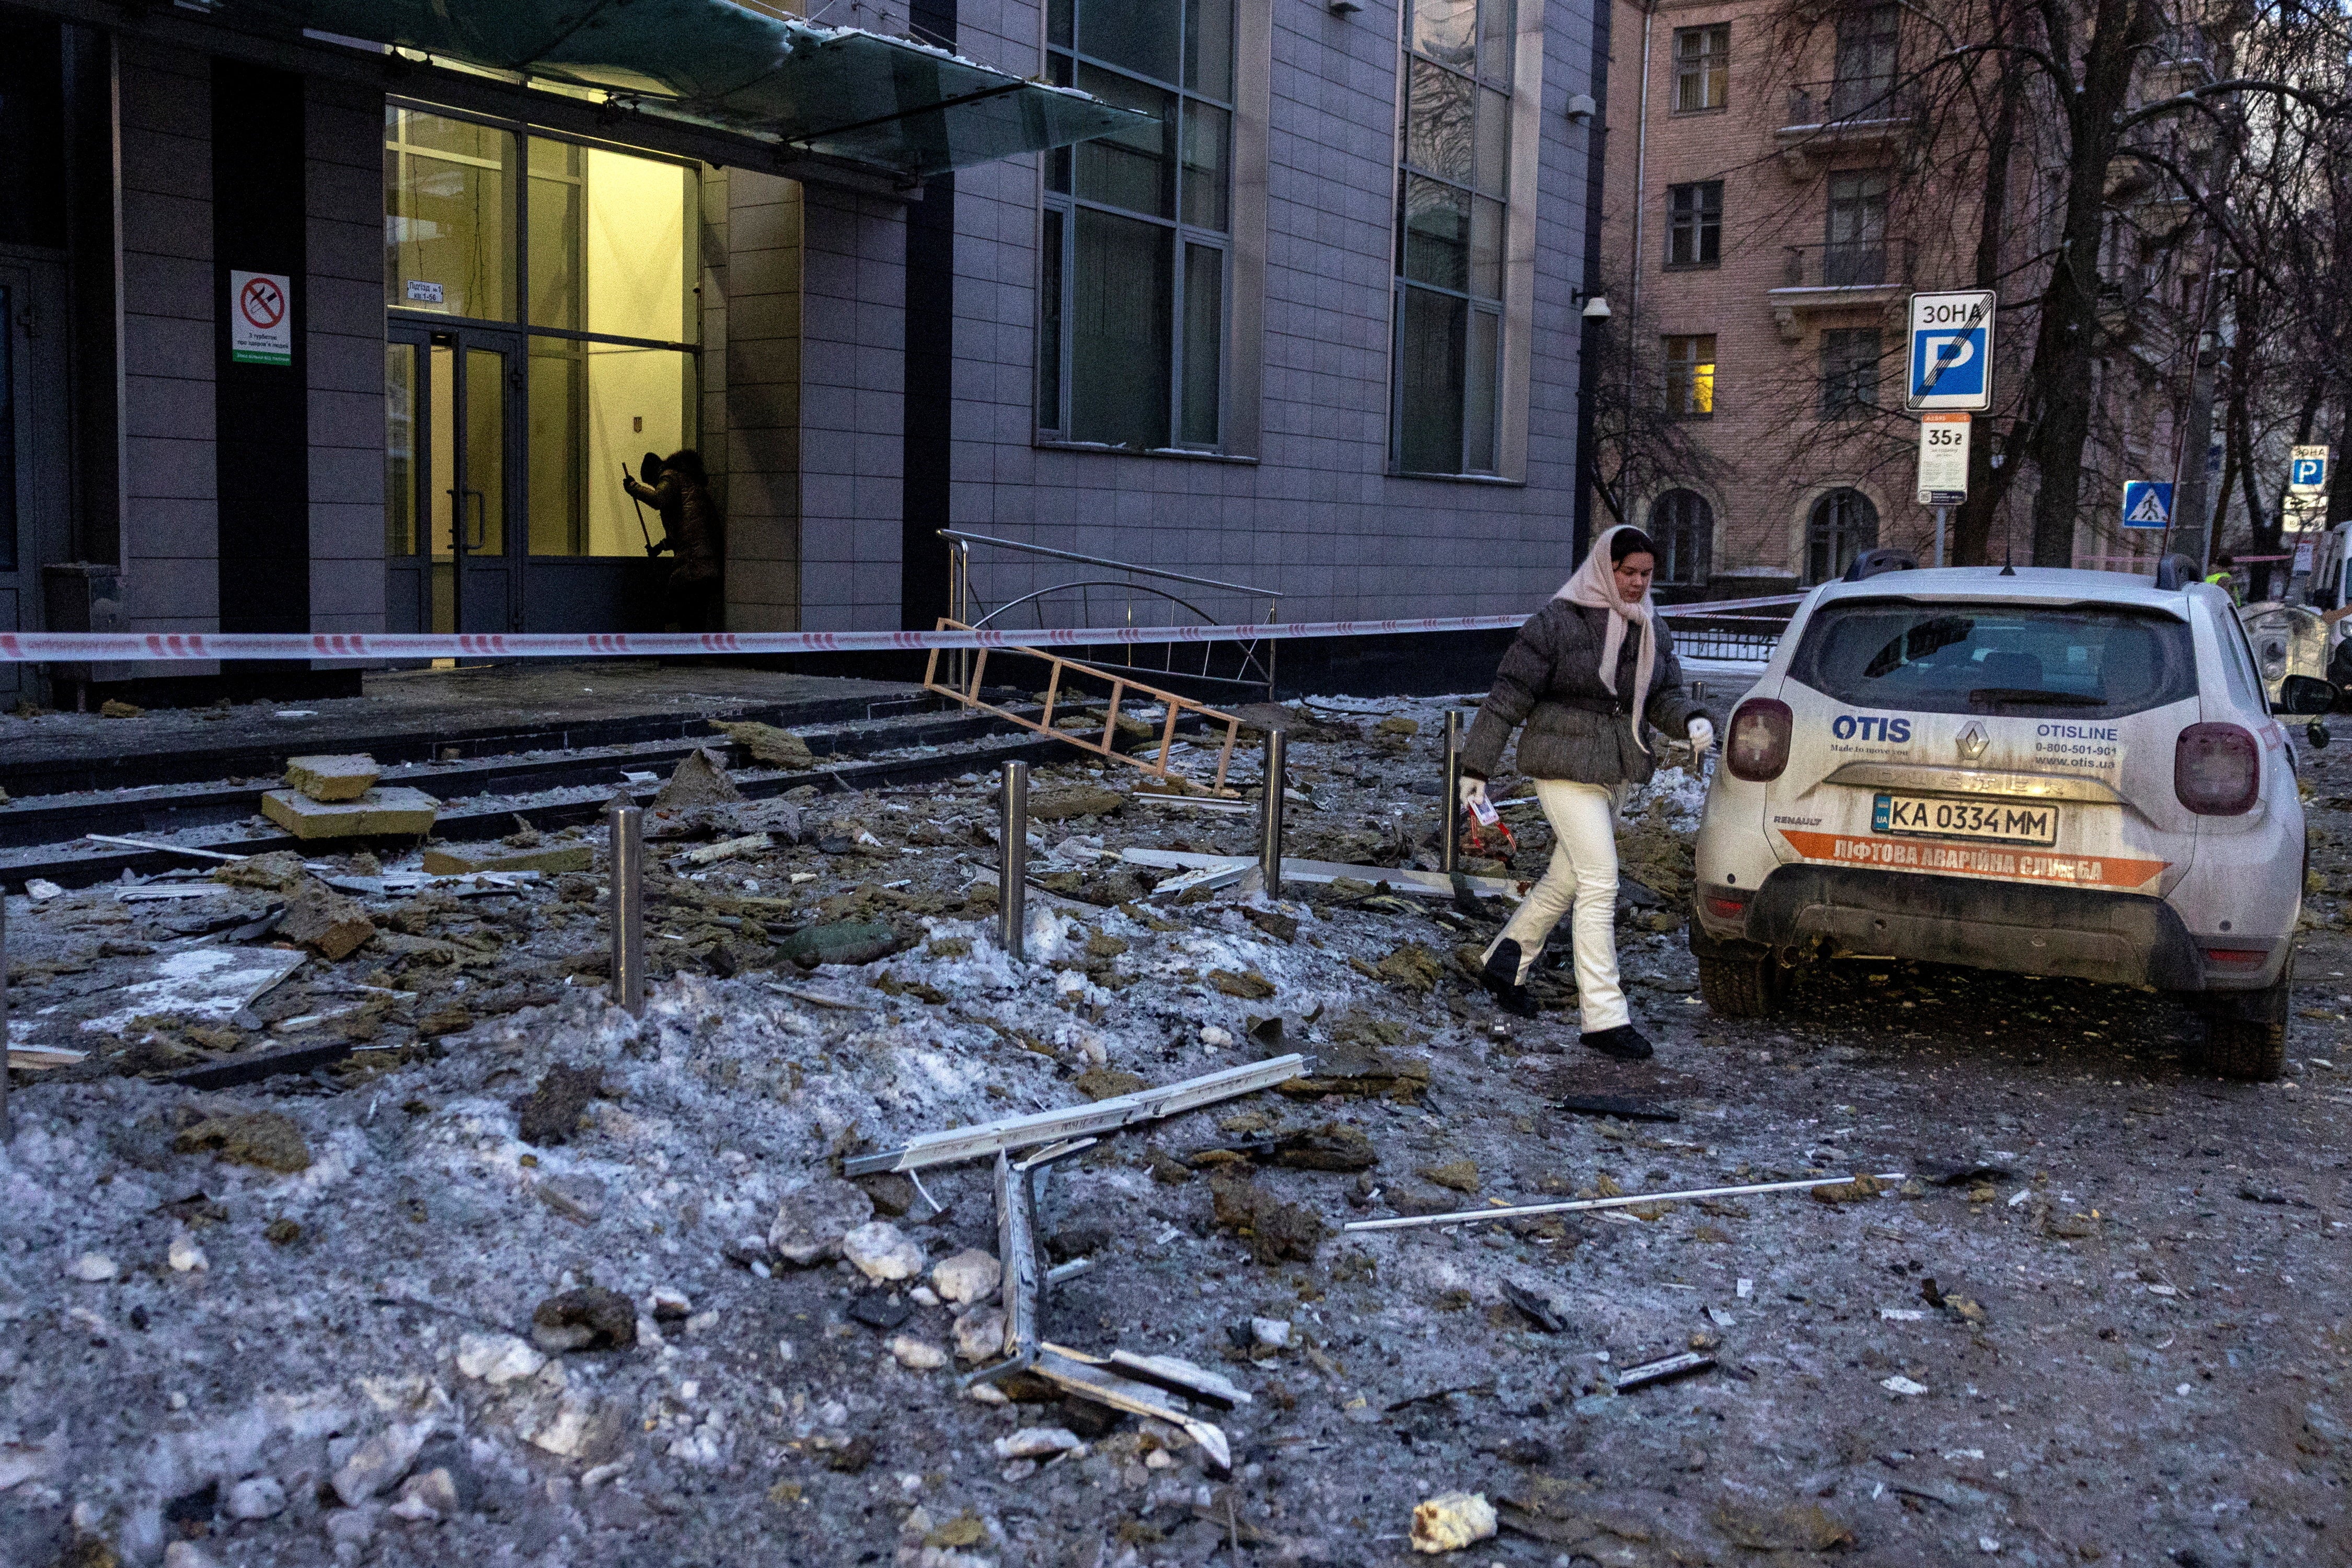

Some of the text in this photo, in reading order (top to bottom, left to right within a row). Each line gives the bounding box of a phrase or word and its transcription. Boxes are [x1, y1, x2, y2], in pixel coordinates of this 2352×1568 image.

[1923, 303, 1982, 324] ЗОНА
[1924, 336, 1974, 386] P
[2294, 447, 2325, 456] ЗОНА
[2299, 461, 2317, 483] P
[1832, 715, 1911, 743] OTIS
[2037, 724, 2118, 741] OTISLINE
[2036, 742, 2117, 756] 0-800-501-901
[2036, 757, 2115, 768] www.otis.ua
[1773, 816, 1823, 826] RENAULT
[1876, 815, 1888, 824] UA
[1834, 839, 2102, 881] ЛІФТОВА АВАРІЙНА СЛУЖБА
